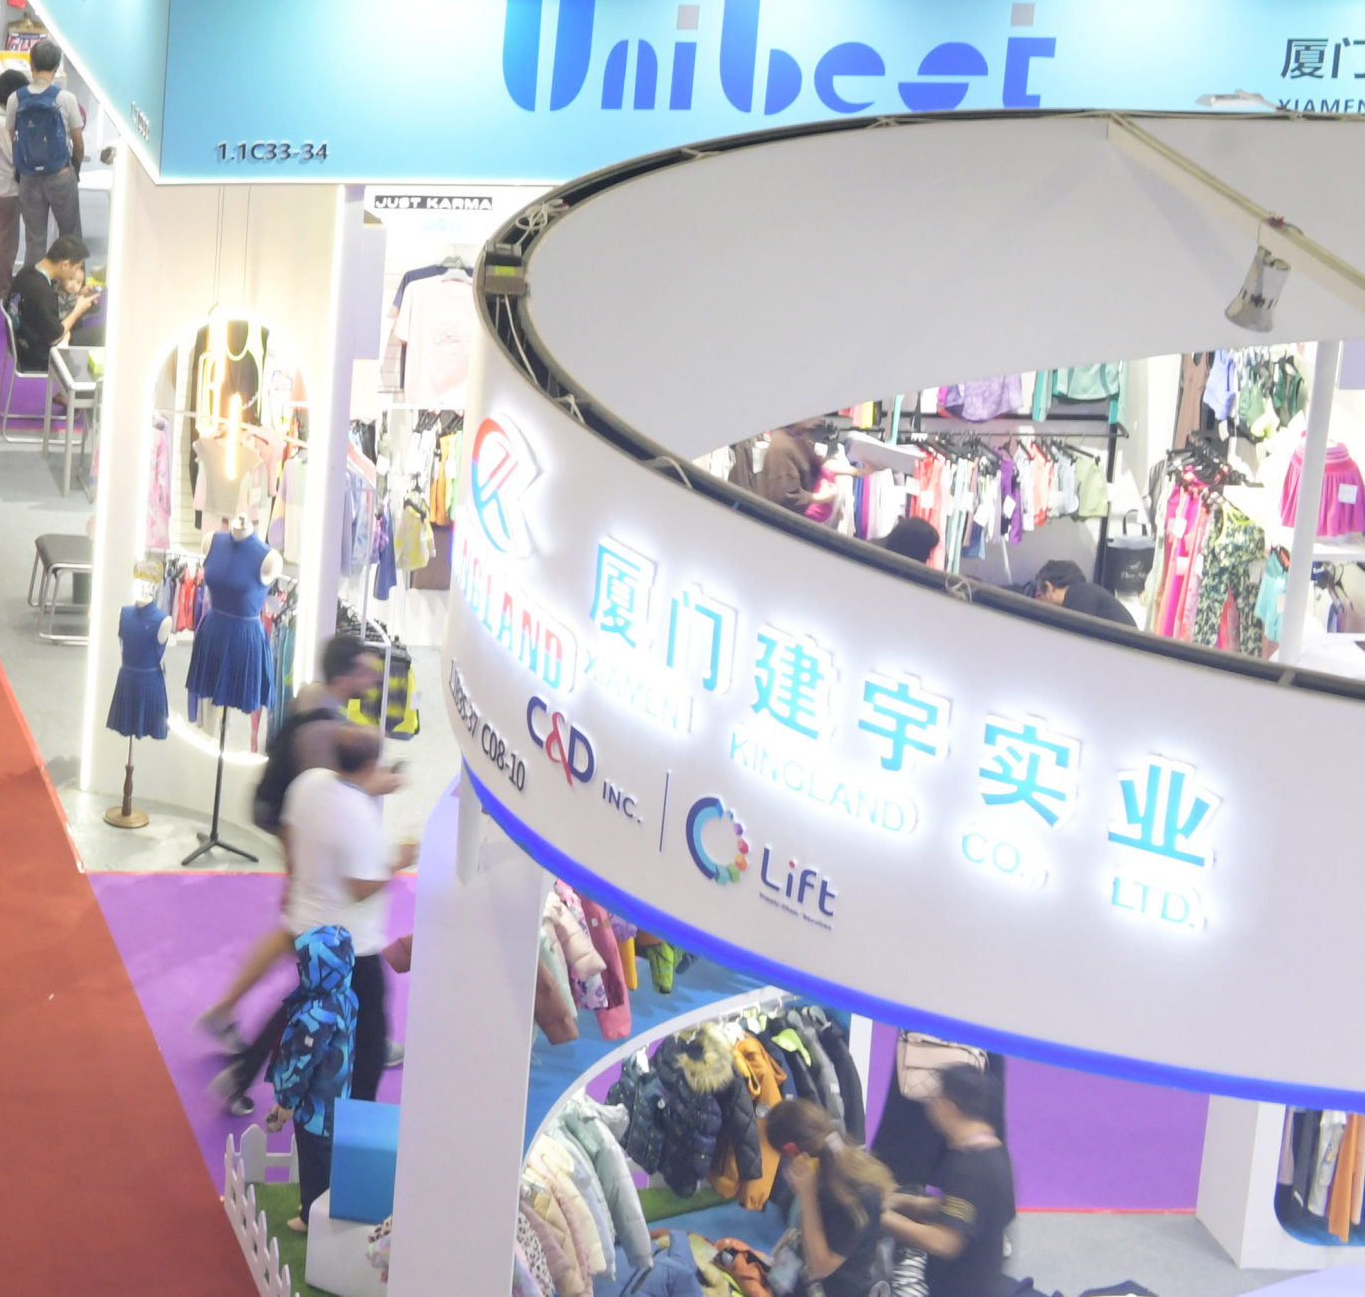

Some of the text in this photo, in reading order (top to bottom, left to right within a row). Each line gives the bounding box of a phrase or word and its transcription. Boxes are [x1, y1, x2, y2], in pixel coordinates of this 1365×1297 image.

[217, 142, 329, 161] 1.1C33-34
[374, 195, 493, 211] JUST KARMA
[589, 541, 1216, 869] 厦门建宇实业
[481, 722, 526, 792] C08-10
[728, 731, 907, 835] KINGLAND
[526, 695, 837, 917] C&D INC. Lift
